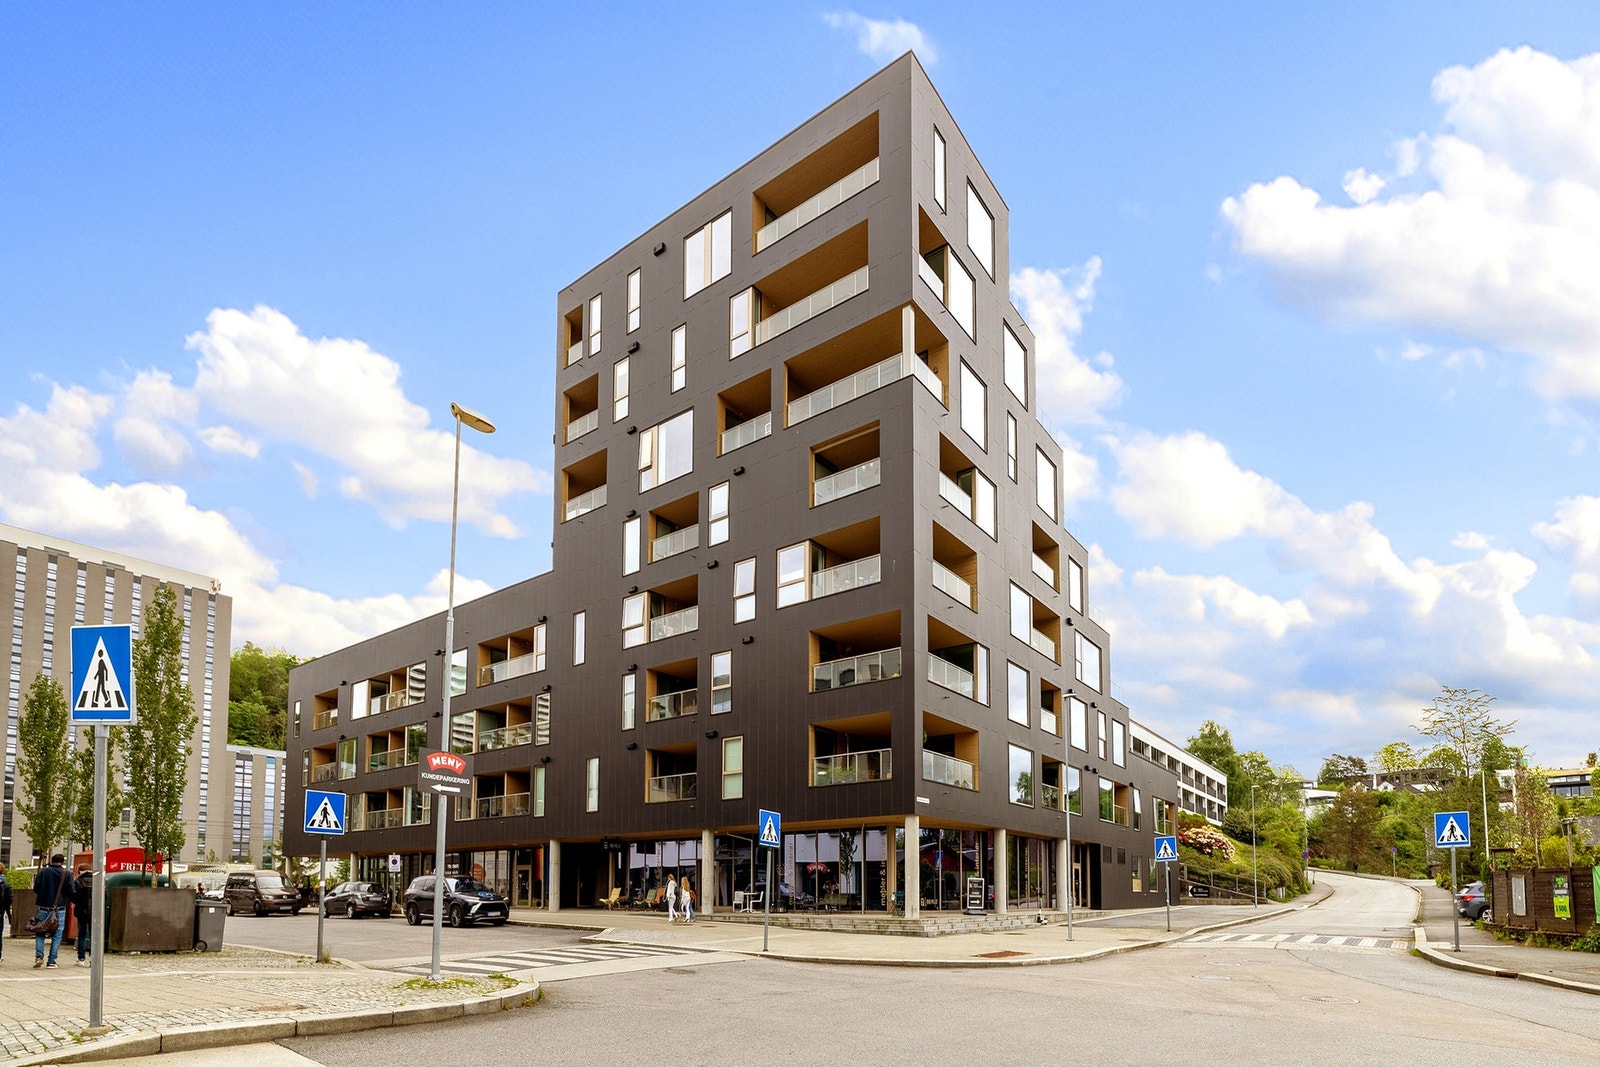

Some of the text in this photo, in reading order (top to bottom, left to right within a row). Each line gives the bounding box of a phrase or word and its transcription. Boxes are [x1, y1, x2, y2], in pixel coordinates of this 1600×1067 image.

[431, 756, 462, 769] MENY
[421, 772, 470, 785] KUNDEPARKERING
[120, 862, 154, 871] FRTE
